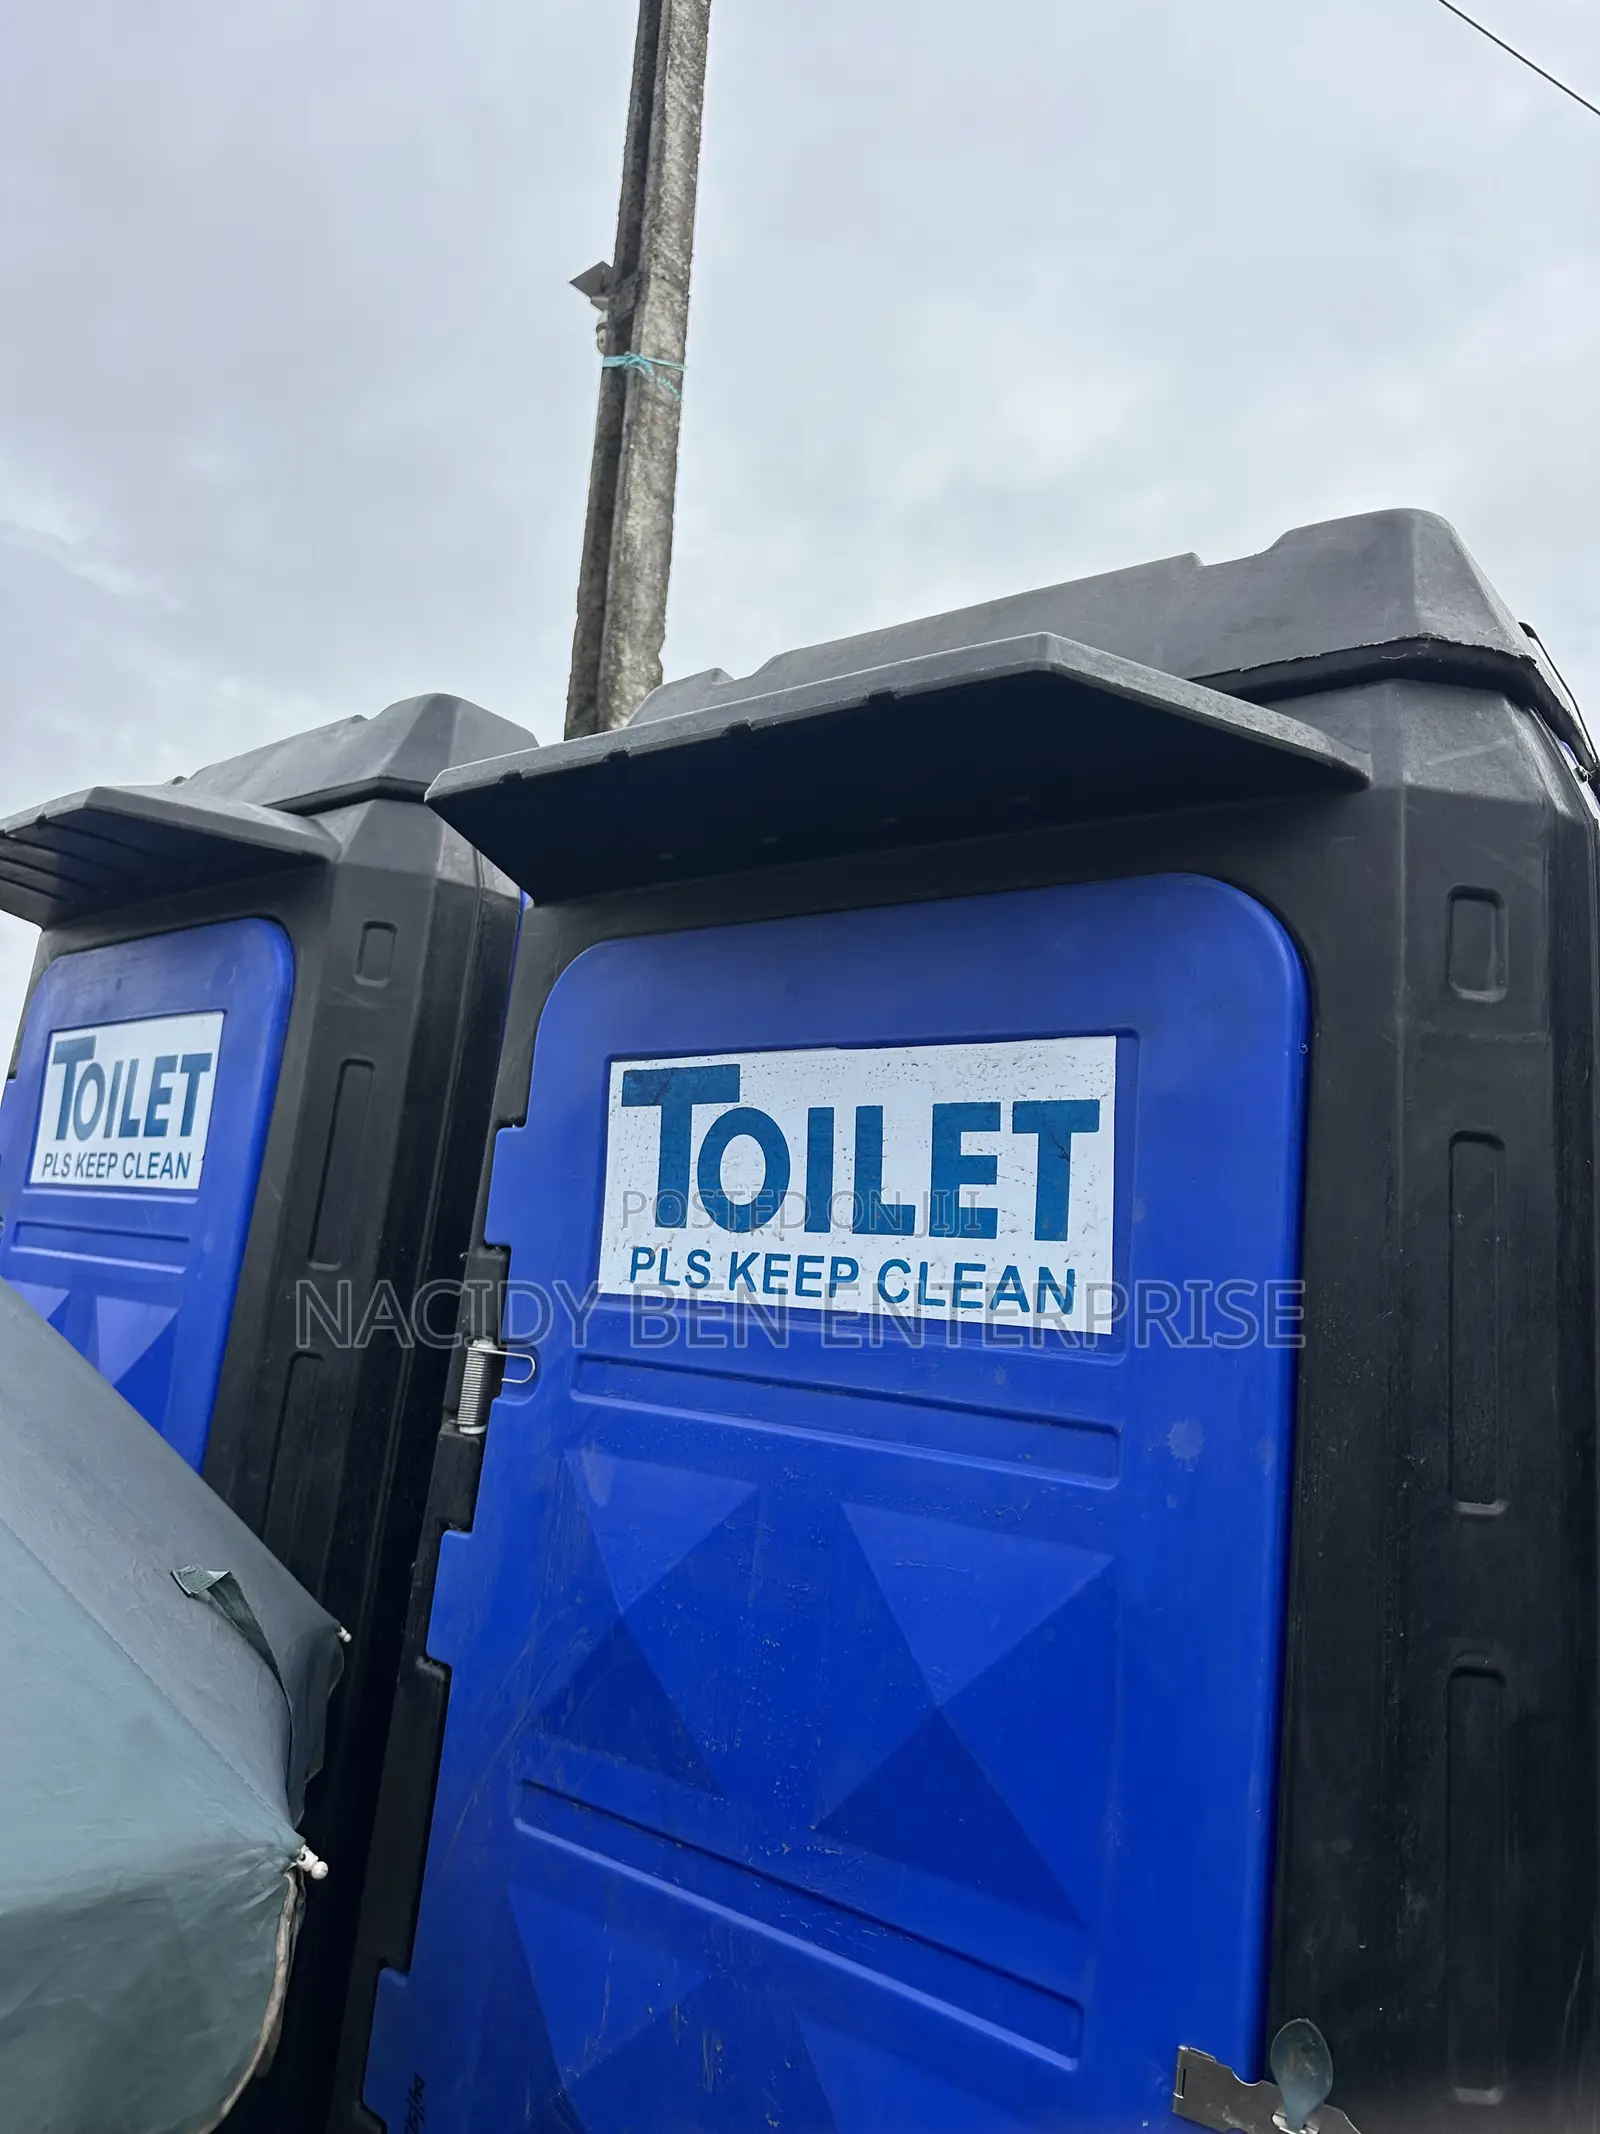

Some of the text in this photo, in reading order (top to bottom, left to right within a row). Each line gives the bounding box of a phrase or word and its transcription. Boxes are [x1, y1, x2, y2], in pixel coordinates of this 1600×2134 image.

[52, 1035, 213, 1142] TOILET
[41, 1152, 192, 1180] PLS KEEP CLEAN
[621, 1063, 1101, 1242] TOILET
[629, 1246, 1077, 1316] PLS KEEP CLEAN
